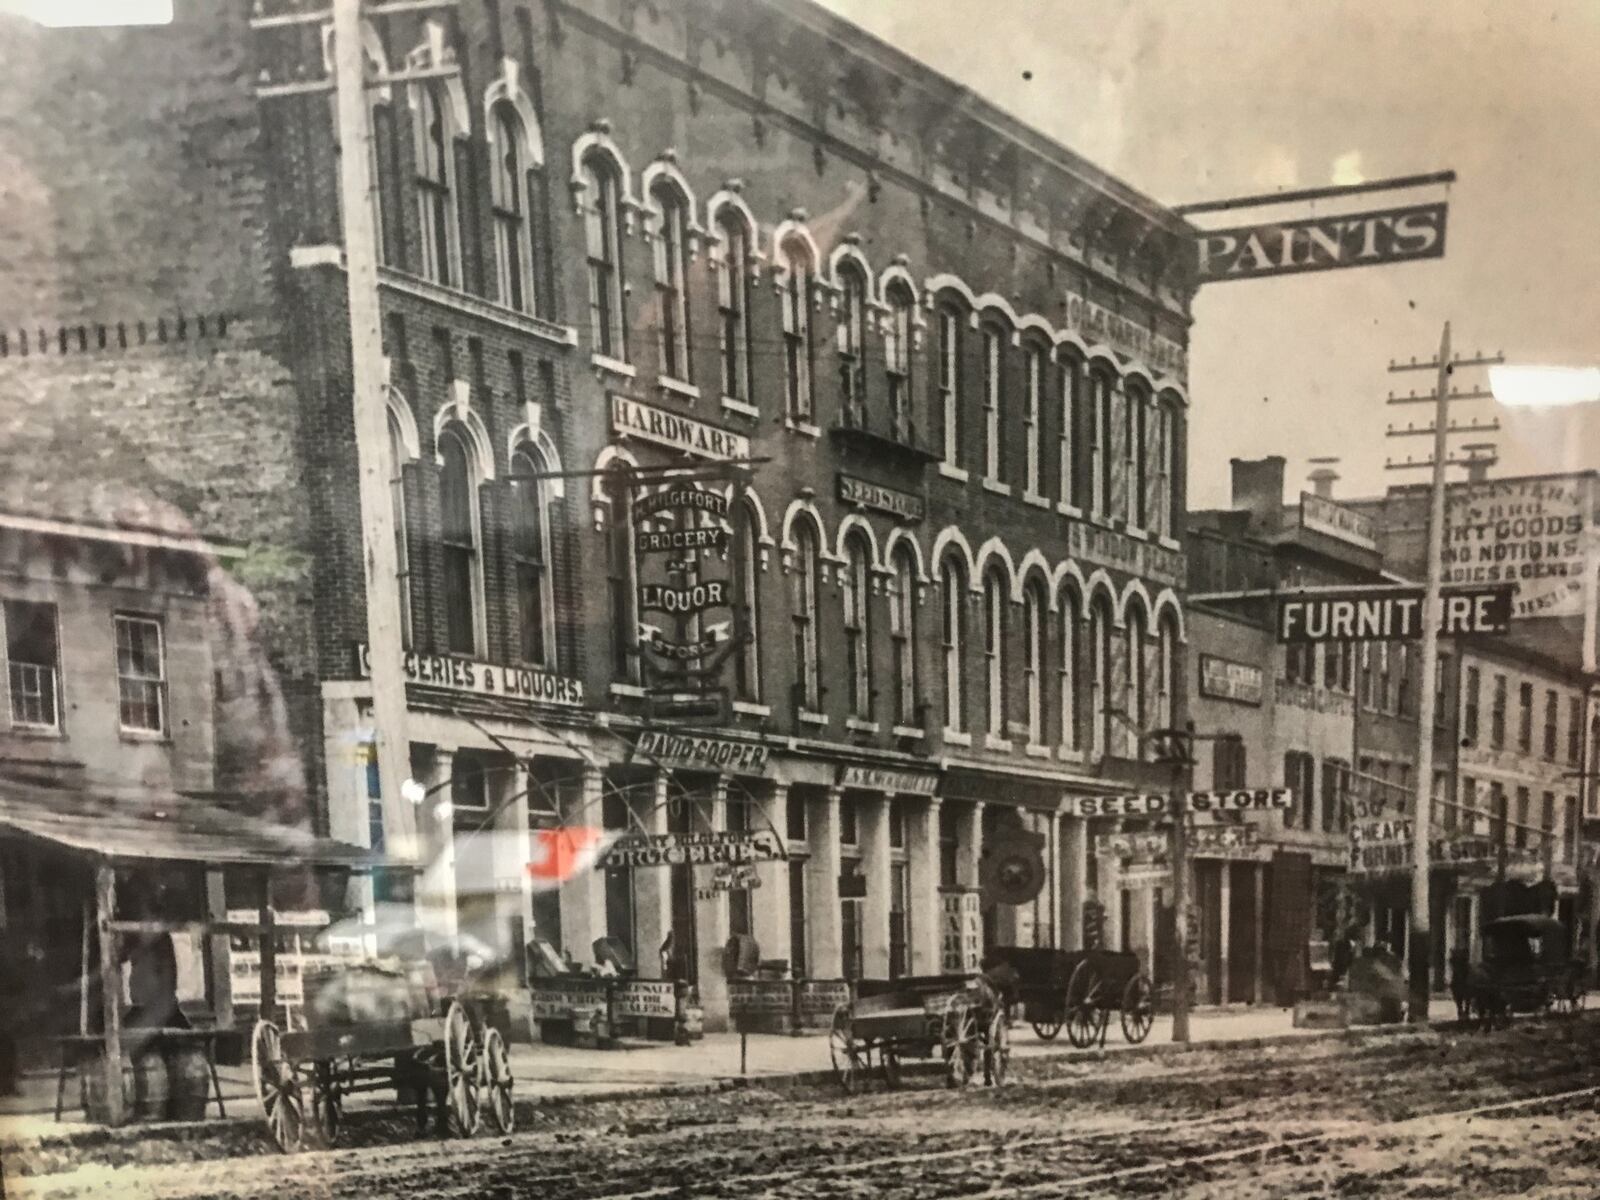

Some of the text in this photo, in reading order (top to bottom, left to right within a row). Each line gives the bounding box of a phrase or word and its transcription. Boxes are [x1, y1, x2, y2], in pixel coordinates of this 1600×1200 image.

[1199, 211, 1439, 275] PAINTS
[613, 399, 738, 457] HARDWARE
[638, 529, 720, 550] GROCERY
[1494, 515, 1583, 540] GOODS
[1441, 566, 1500, 582] ADIES
[642, 583, 722, 611] LIQUOR
[1282, 595, 1506, 639] FURNITRE.
[653, 640, 712, 658] STORE
[484, 668, 495, 690] &
[503, 666, 584, 700] LIQUORS.
[640, 732, 693, 759] DAVID
[1079, 794, 1165, 814] SEED
[1190, 790, 1287, 811] STORE
